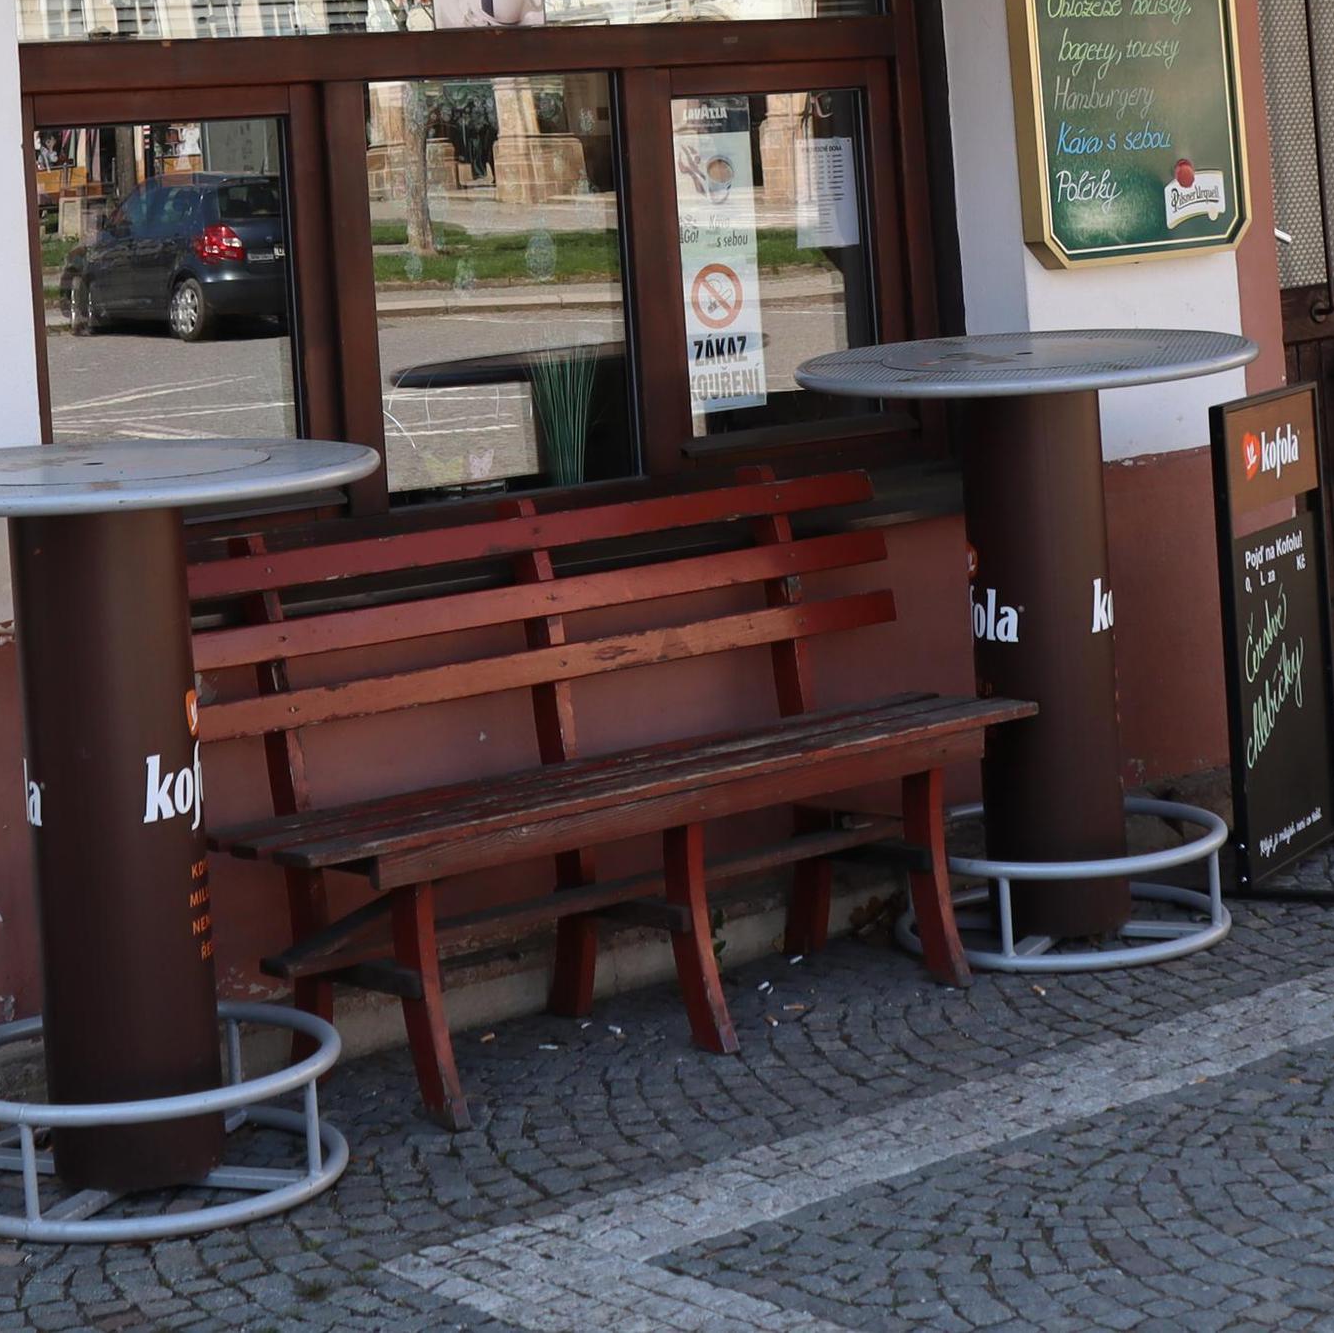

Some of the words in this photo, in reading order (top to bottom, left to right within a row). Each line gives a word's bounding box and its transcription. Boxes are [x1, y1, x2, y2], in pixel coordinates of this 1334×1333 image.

[1058, 27, 1122, 80] bagety,
[1126, 39, 1180, 69] tousty
[682, 103, 728, 122] LAVAZZA
[1054, 75, 1156, 120] Hamburgery
[1056, 121, 1103, 155] Káva
[1107, 133, 1116, 151] s
[1123, 121, 1172, 151] sebou
[1056, 169, 1123, 213] Polévky
[1170, 188, 1196, 214] Pilsner
[723, 229, 748, 247] sebou
[694, 334, 748, 366] ZÁKAZ
[1261, 423, 1299, 479] kofola
[1265, 545, 1276, 563] na
